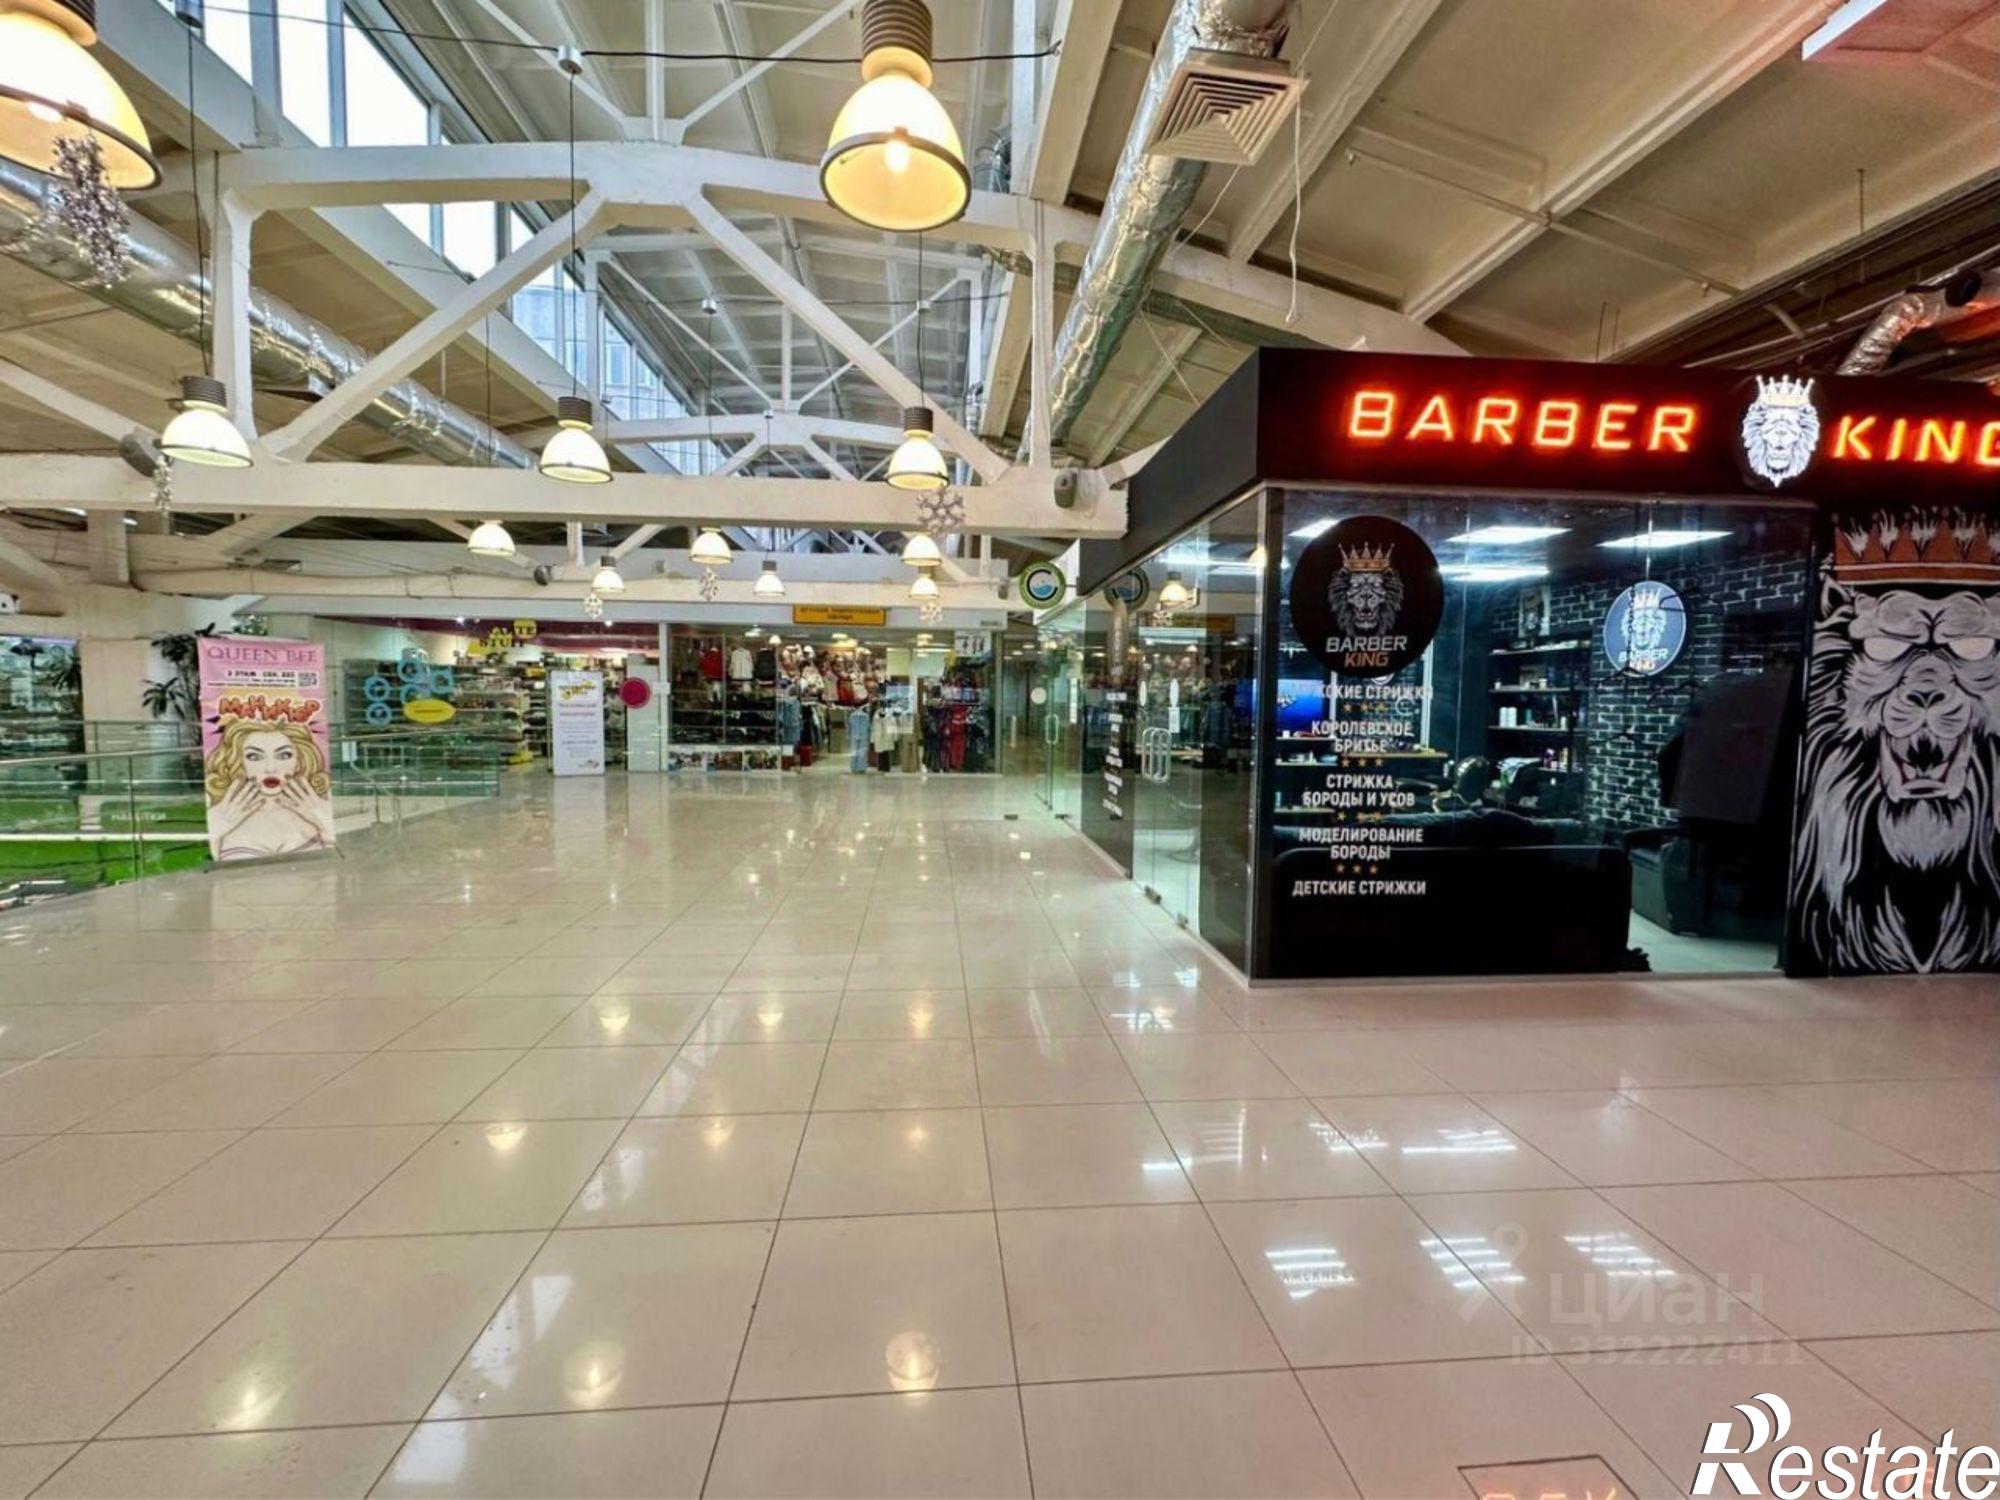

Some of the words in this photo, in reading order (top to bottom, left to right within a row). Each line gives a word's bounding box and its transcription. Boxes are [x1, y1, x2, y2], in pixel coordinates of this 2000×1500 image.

[1349, 390, 1697, 452] BARBER
[1326, 636, 1408, 652] BARBER
[207, 646, 278, 661] QUEEN
[286, 650, 317, 662] BEE
[1344, 652, 1390, 668] KING
[1295, 684, 1363, 699] ЖСКИЕ
[1311, 720, 1415, 736] КОРОЛЕВСКОЕ
[1334, 738, 1387, 753] БРИТЬЕ
[1326, 774, 1393, 788] СТРИЖКА
[1302, 791, 1363, 808] БОРОДЫ
[1366, 792, 1377, 806] И
[1380, 792, 1415, 807] УСОВ
[1299, 828, 1424, 843] МОДЕЛИРОВАНИЕ
[1330, 845, 1391, 861] БОРОДЫ
[1292, 880, 1356, 897] ДЕТСКИЕ
[1358, 880, 1426, 894] СТРИЖКИ
